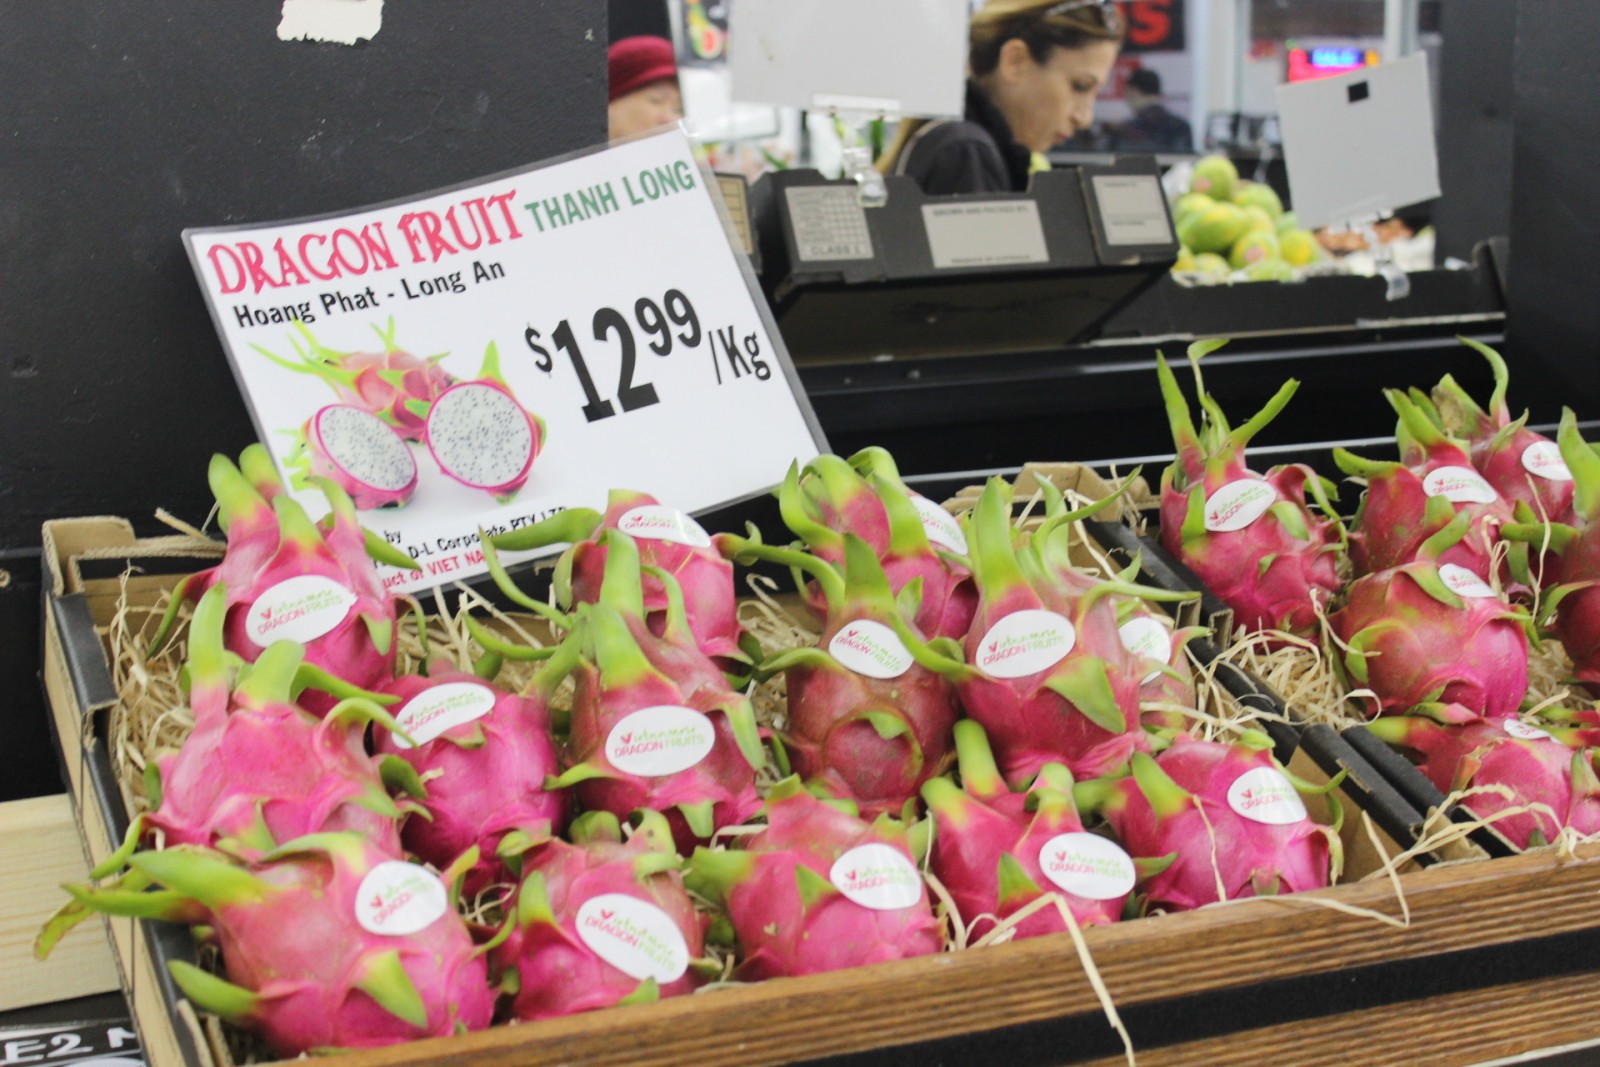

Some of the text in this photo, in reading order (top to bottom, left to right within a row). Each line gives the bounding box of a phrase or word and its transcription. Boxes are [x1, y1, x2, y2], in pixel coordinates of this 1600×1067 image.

[207, 160, 697, 294] DRAGON FRUIT THANH LONG
[810, 245, 850, 255] CLASS
[233, 304, 316, 327] Hoang
[319, 286, 380, 315] Phat
[400, 271, 466, 300] Long
[473, 260, 506, 284] An
[384, 529, 401, 544] by
[408, 542, 434, 559] D-L
[426, 556, 461, 575] VIET
[464, 550, 491, 566] NA
[257, 608, 305, 635] DRAGON
[834, 636, 871, 654] DRAGON
[983, 635, 1065, 666] DRAGON FRUITS
[614, 735, 705, 758] DRAGON FRUITS
[584, 915, 638, 947] DRAGON
